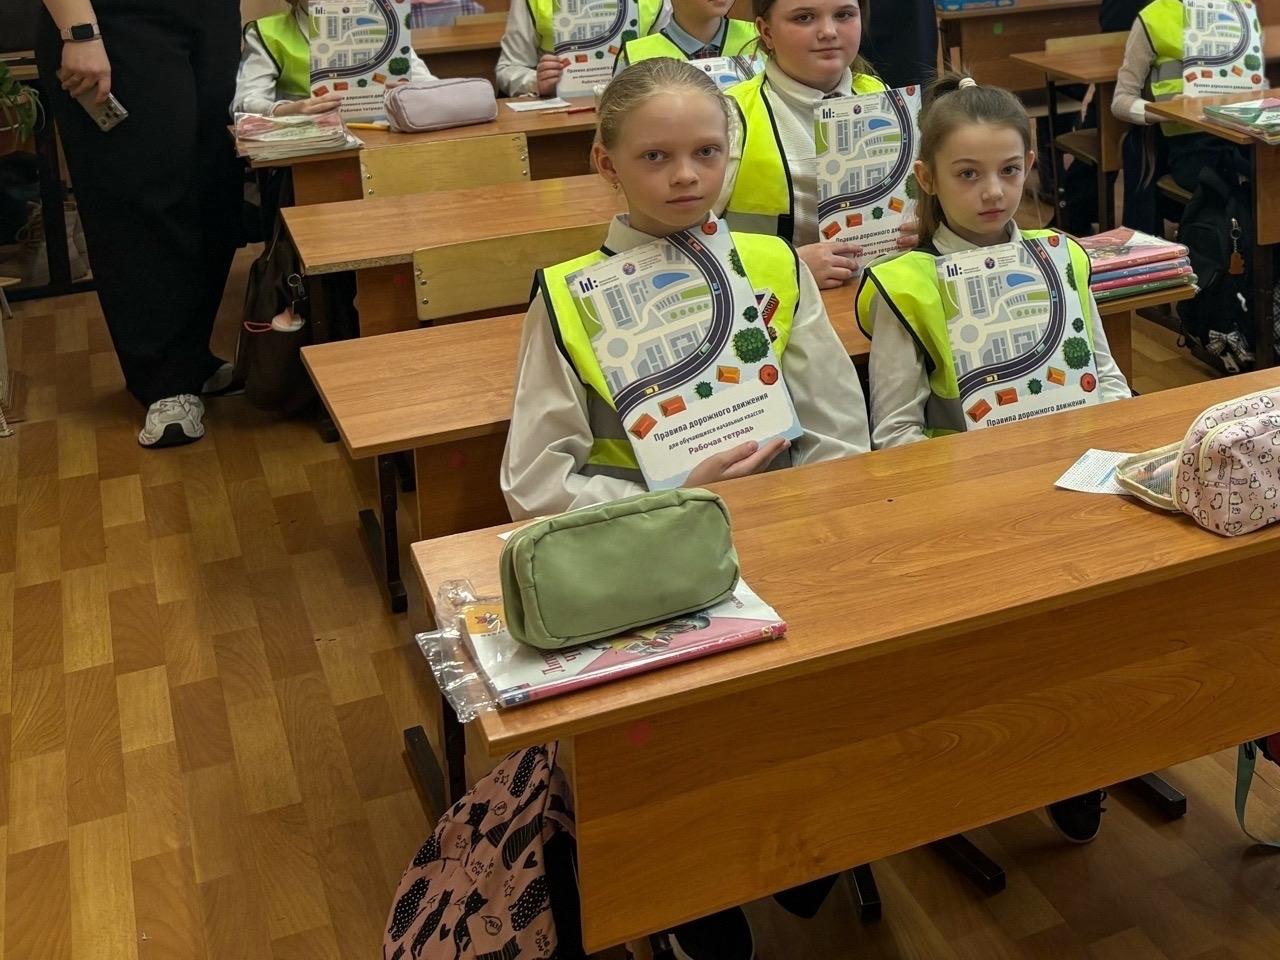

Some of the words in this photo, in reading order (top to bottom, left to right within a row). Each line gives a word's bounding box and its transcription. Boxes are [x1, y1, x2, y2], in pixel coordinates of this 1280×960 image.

[859, 228, 891, 239] дорожного
[653, 423, 688, 442] Правила
[689, 406, 732, 429] дорожного
[732, 393, 769, 412] движения
[986, 414, 1017, 427] Правила
[1017, 406, 1055, 420] дорожного
[1055, 398, 1087, 412] движения
[668, 442, 679, 450] для
[679, 428, 717, 446] обучающихся
[716, 417, 744, 431] начальных
[744, 408, 765, 420] классов
[688, 438, 722, 455] Рабочая
[723, 425, 755, 441] тетрадь
